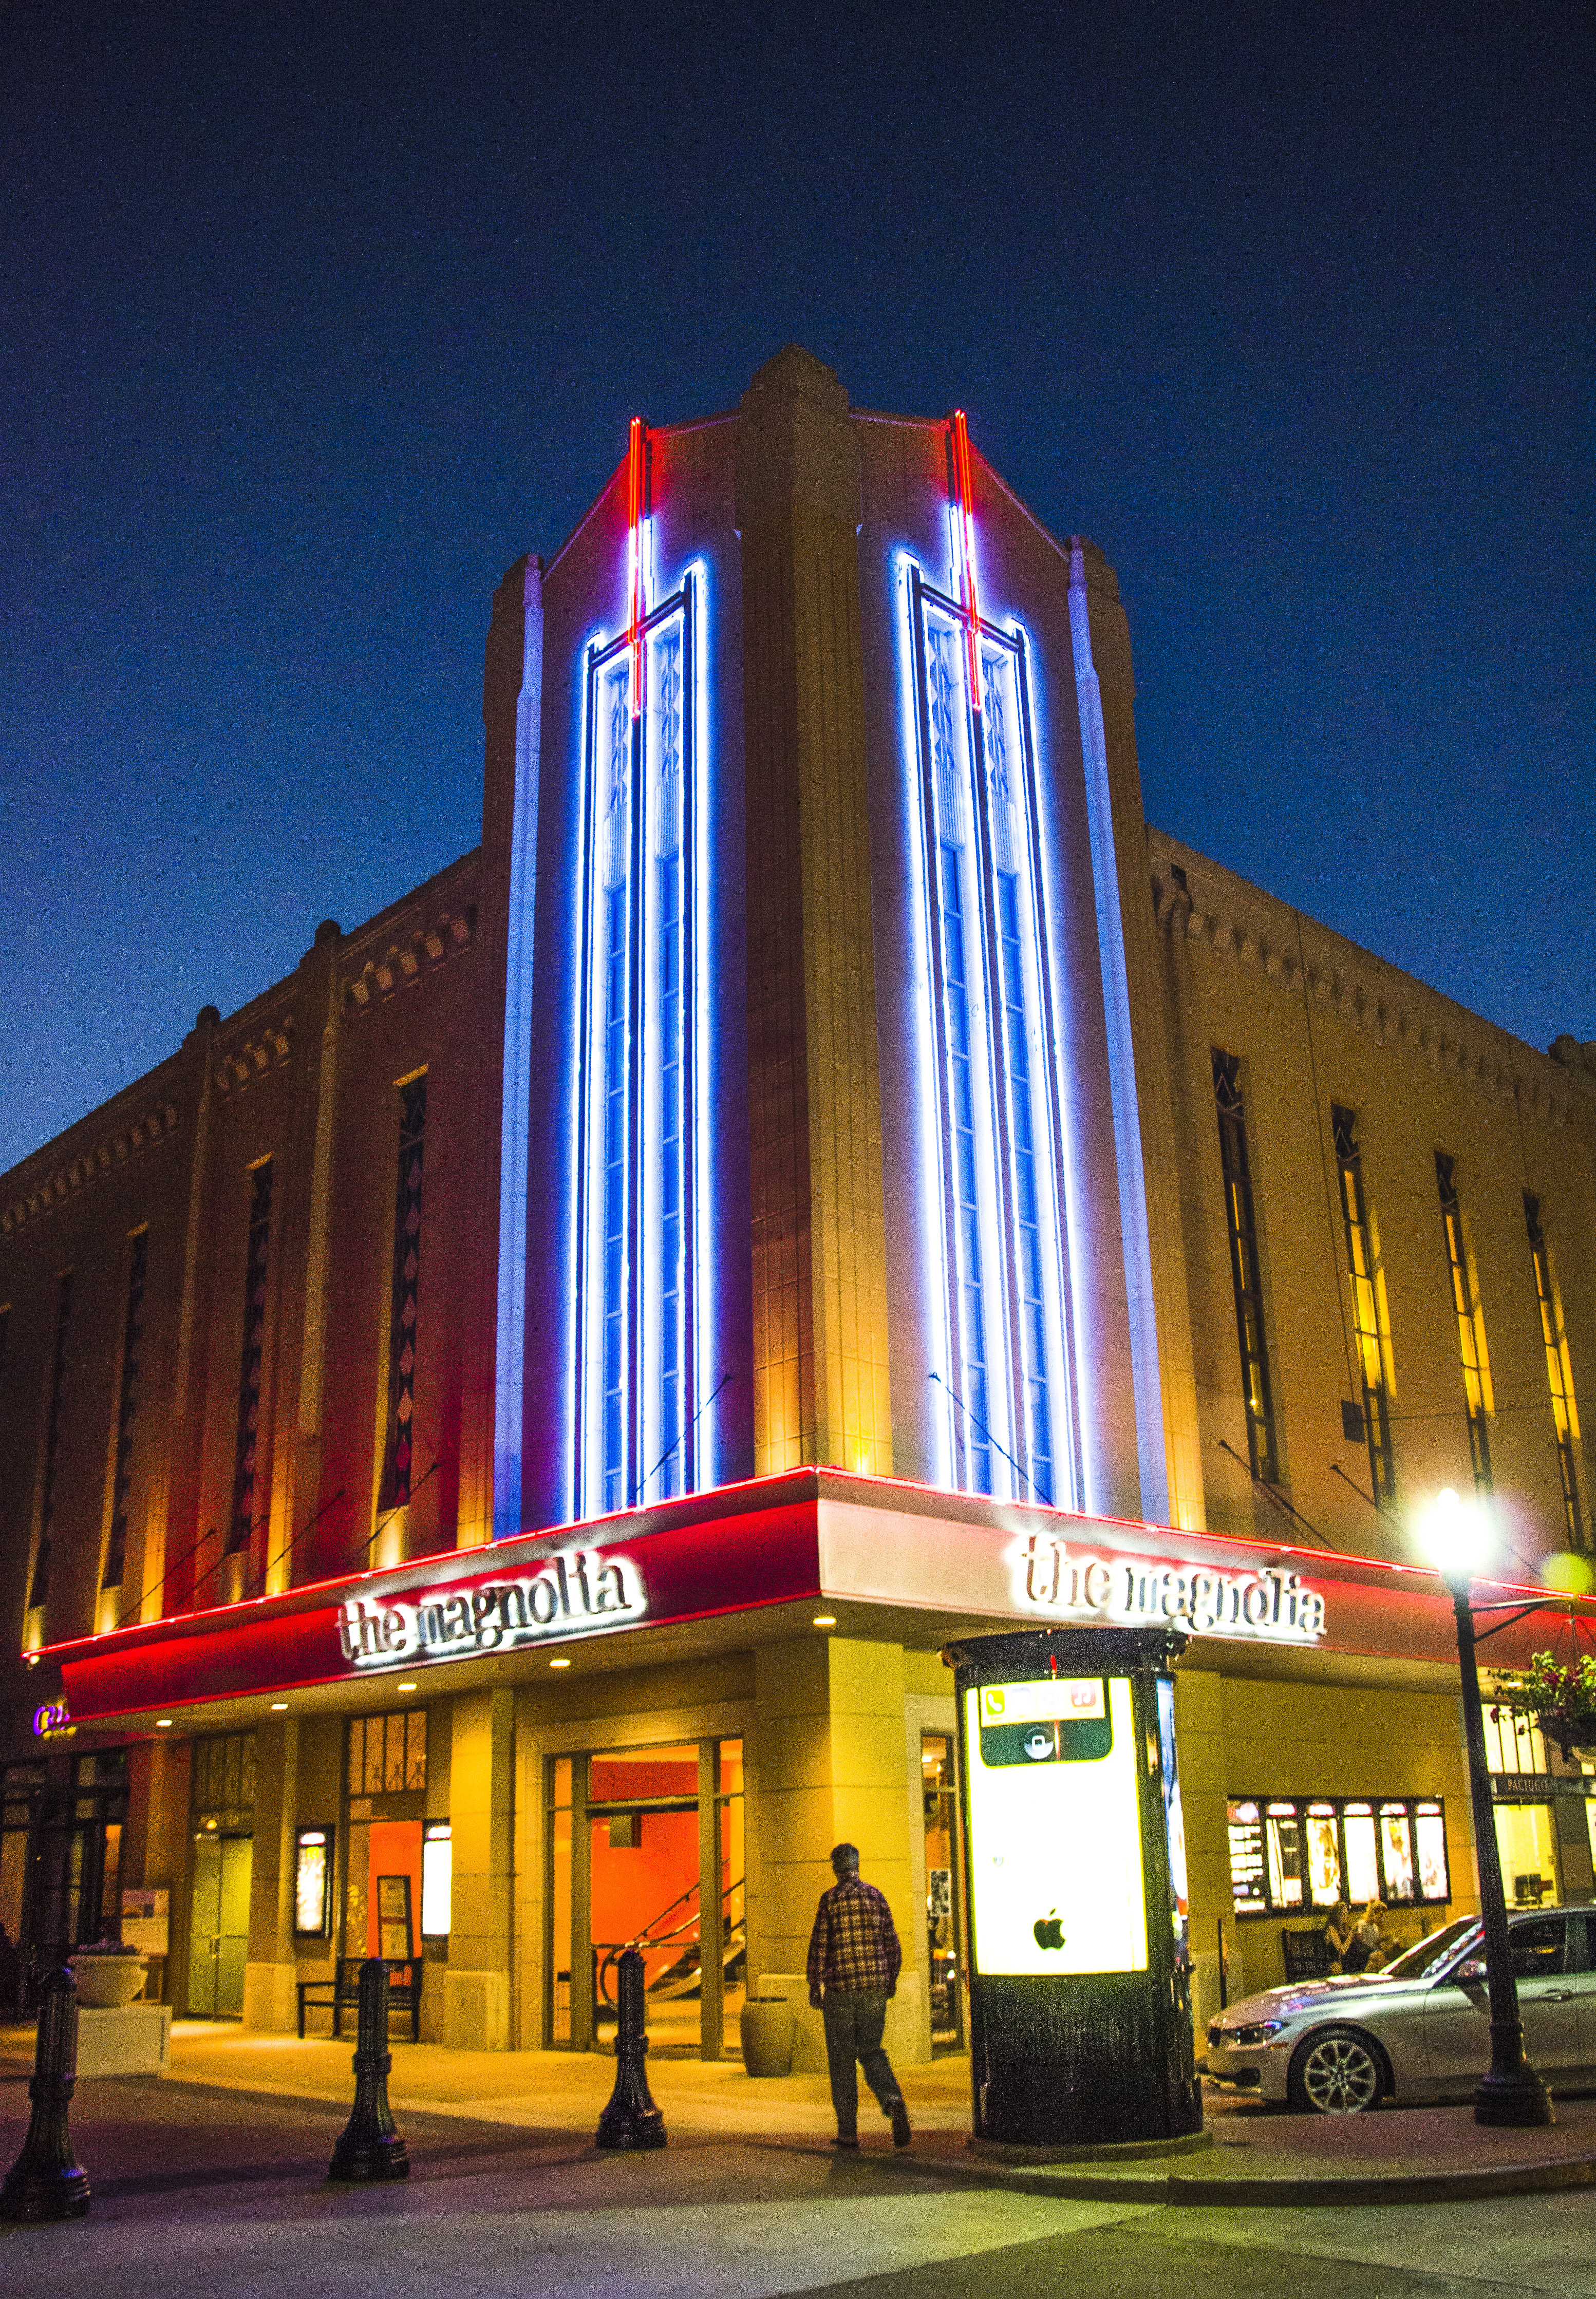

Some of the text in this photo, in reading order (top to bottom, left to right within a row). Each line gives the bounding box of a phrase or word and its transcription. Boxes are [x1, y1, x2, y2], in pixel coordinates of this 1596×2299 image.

[336, 1551, 632, 1660] the magnolia
[1021, 1536, 1327, 1635] the magnolia
